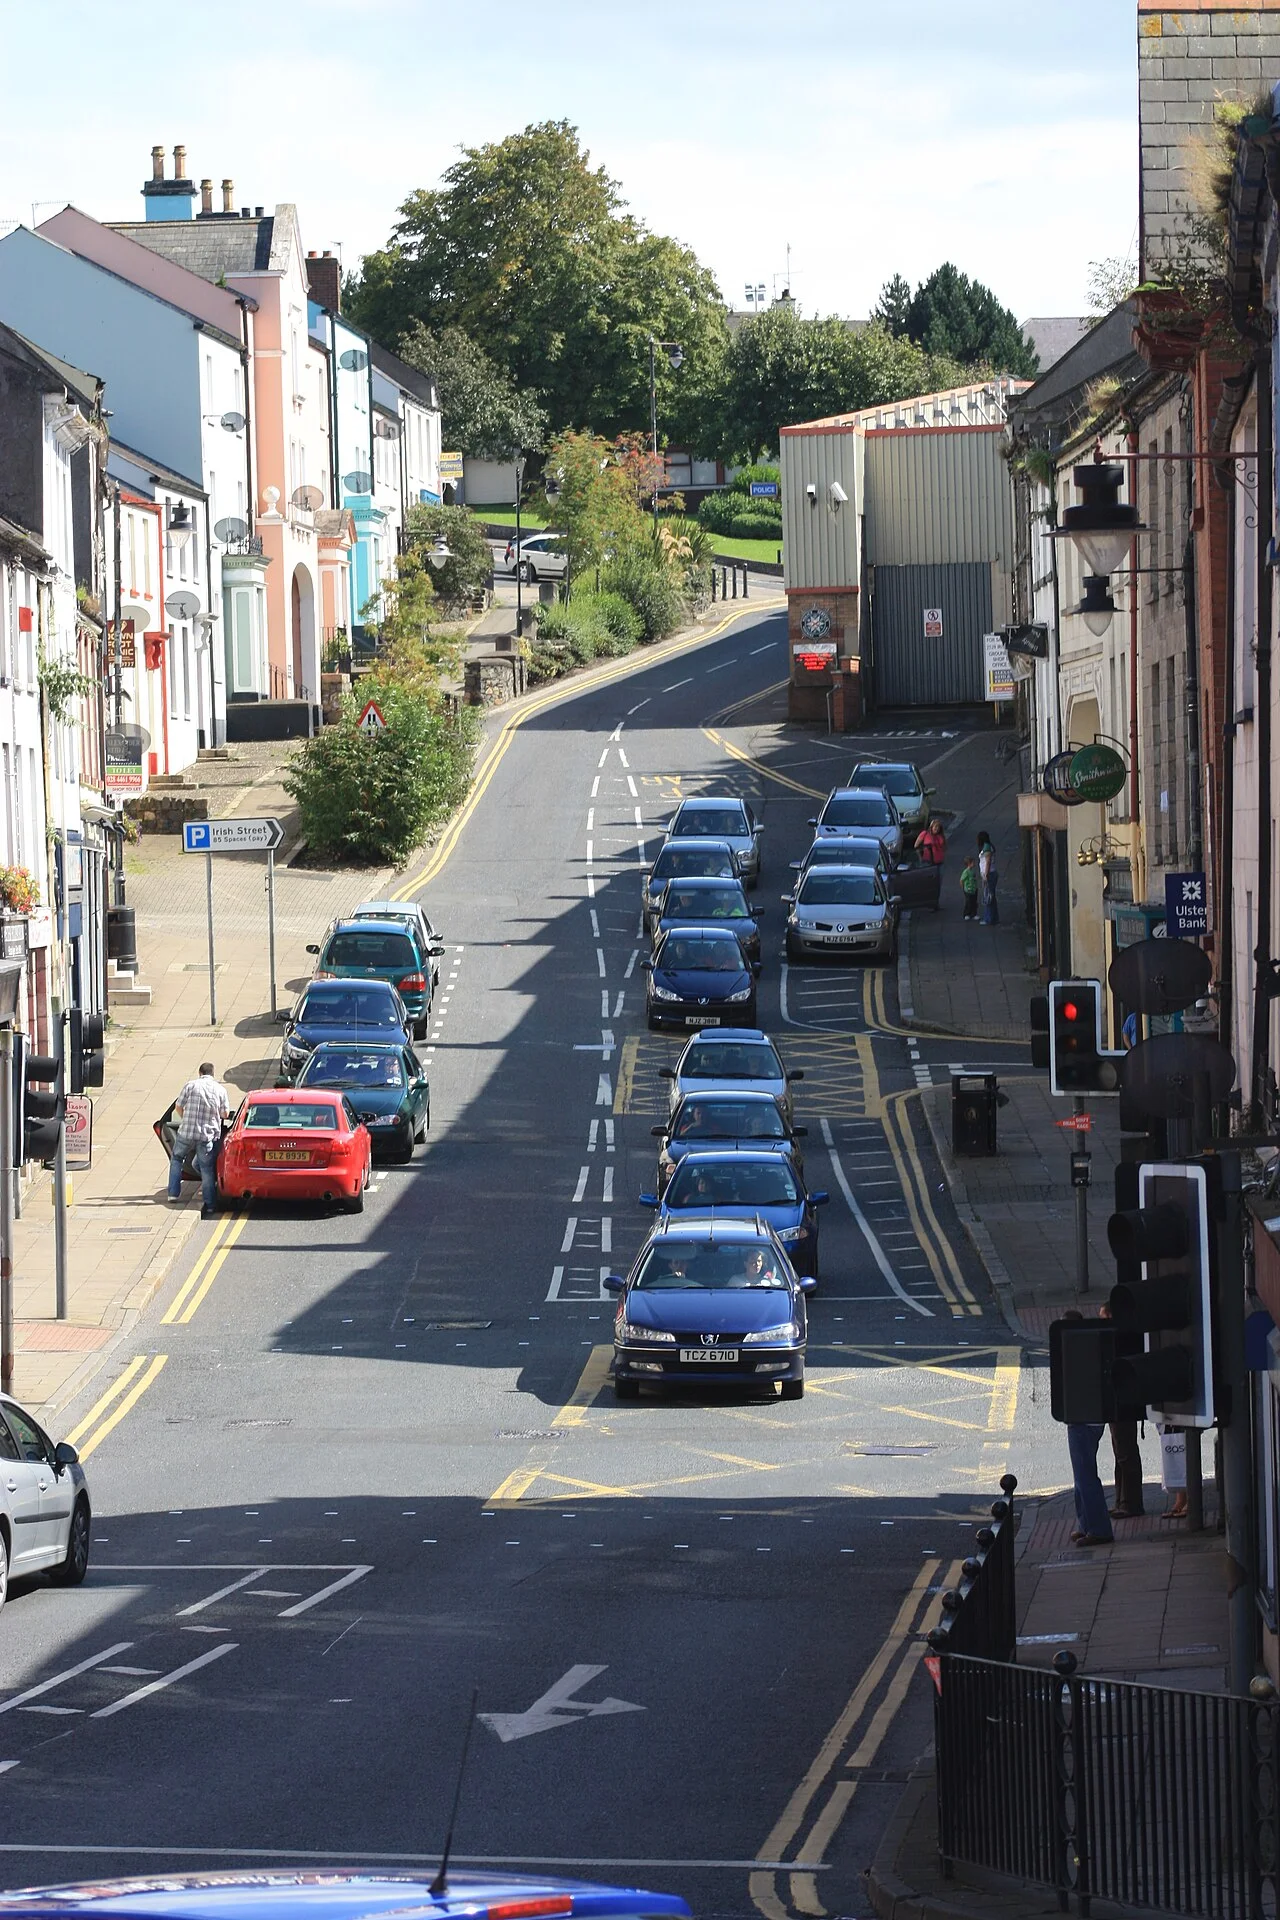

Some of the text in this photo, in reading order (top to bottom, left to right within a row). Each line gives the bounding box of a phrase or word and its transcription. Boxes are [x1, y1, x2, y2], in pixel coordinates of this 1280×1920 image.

[191, 826, 267, 846] P Irish Street
[1179, 918, 1206, 928] Bank
[268, 1152, 284, 1160] SLZ
[684, 1350, 735, 1361] TCZ 6710
